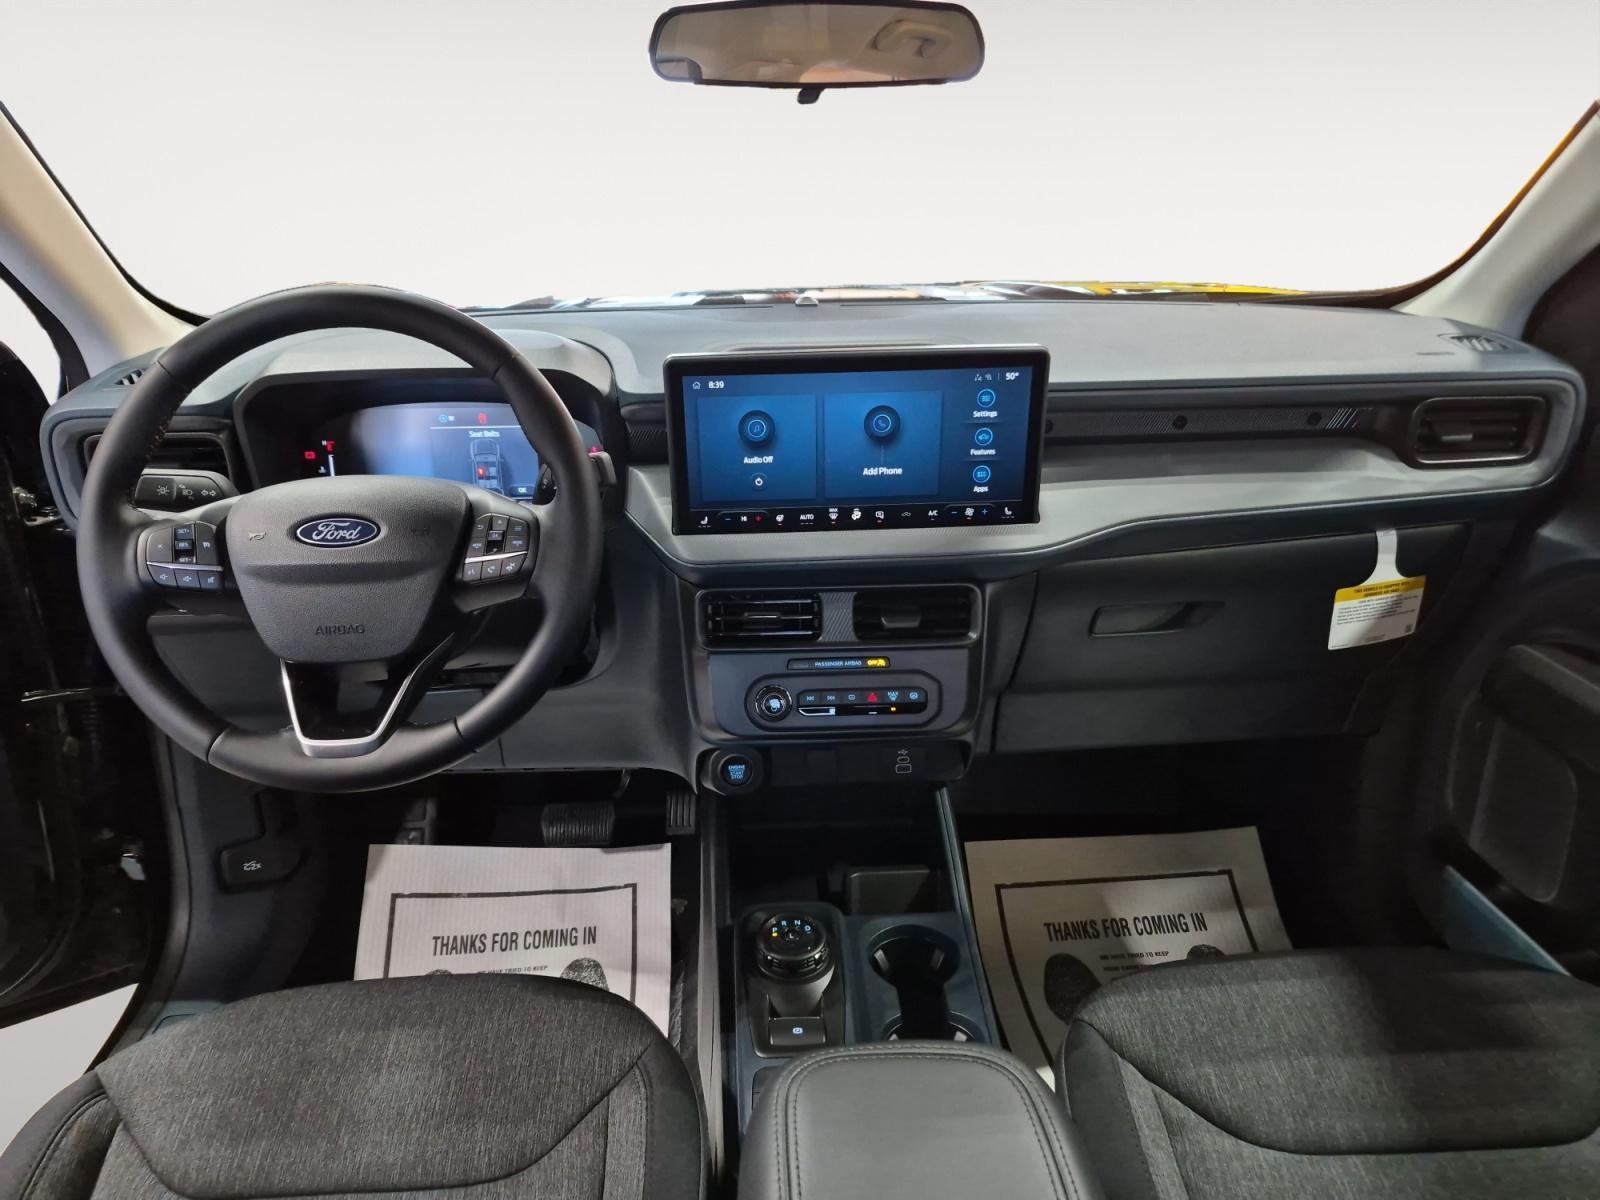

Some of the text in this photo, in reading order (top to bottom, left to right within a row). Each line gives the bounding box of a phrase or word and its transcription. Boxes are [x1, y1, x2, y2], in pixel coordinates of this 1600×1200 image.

[1005, 371, 1020, 380] 50°
[708, 380, 725, 389] 8:39
[973, 410, 998, 419] Settings
[970, 448, 996, 456] Features
[743, 455, 774, 464] Audio Off
[863, 466, 903, 476] Add Phone
[973, 486, 989, 494] Apps
[927, 509, 939, 517] A/C
[312, 521, 362, 540] Ford
[315, 623, 366, 636] AIRBAG
[1043, 912, 1208, 942] THANKS FOR COMING IN
[432, 925, 597, 956] THANKS FOR COMING IN
